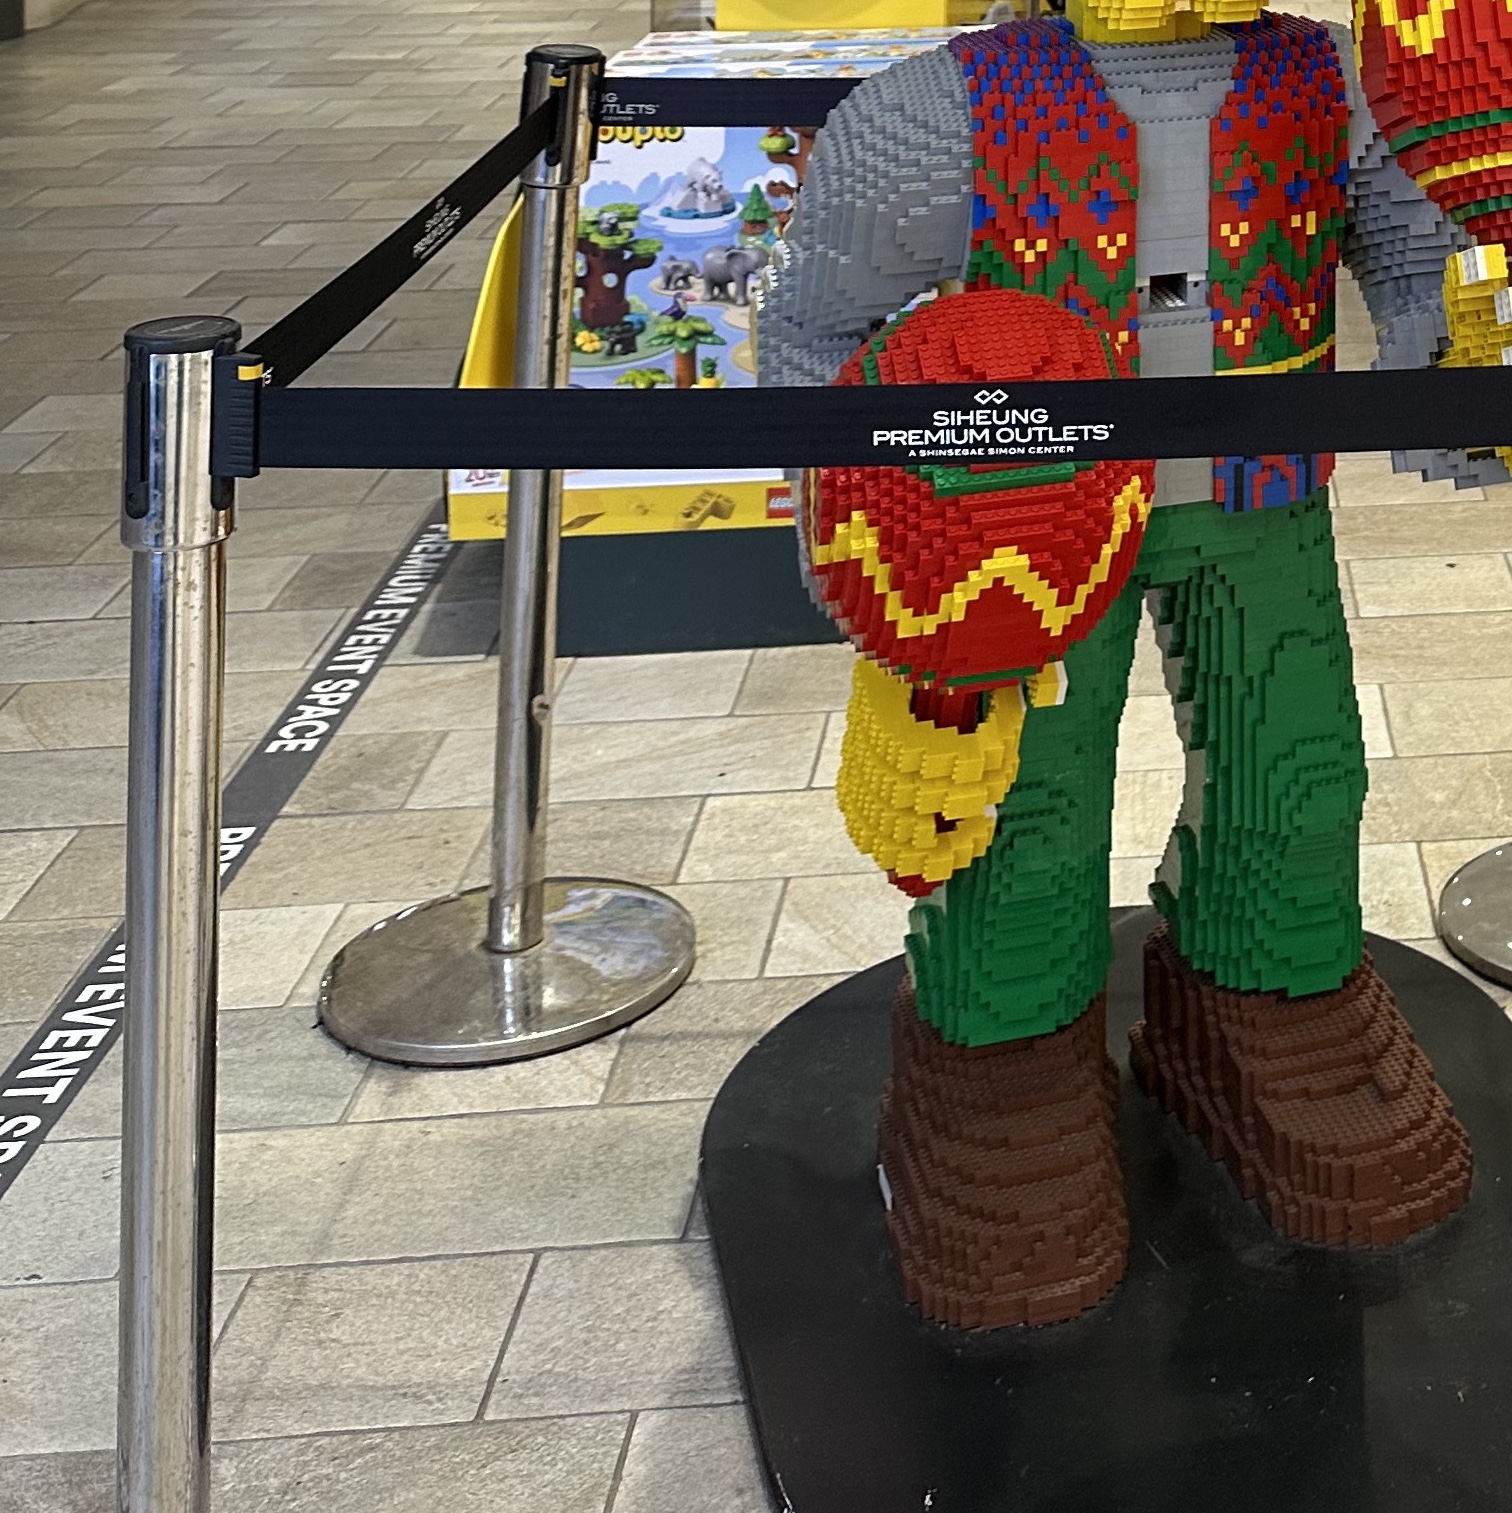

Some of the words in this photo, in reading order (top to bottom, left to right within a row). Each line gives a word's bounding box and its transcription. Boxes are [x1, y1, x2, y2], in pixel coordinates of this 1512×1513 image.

[872, 428, 990, 447] PREMIUM
[995, 424, 1112, 445] OUTLETS
[933, 408, 1049, 427] SIHEUNG
[908, 449, 917, 457] A
[919, 448, 985, 457] SHINSEGAE
[987, 446, 1026, 455] SIMON
[1028, 445, 1075, 455] CENTER
[326, 608, 411, 675] EVENT
[264, 678, 361, 754] SPACE
[2, 982, 126, 1104] EVENT
